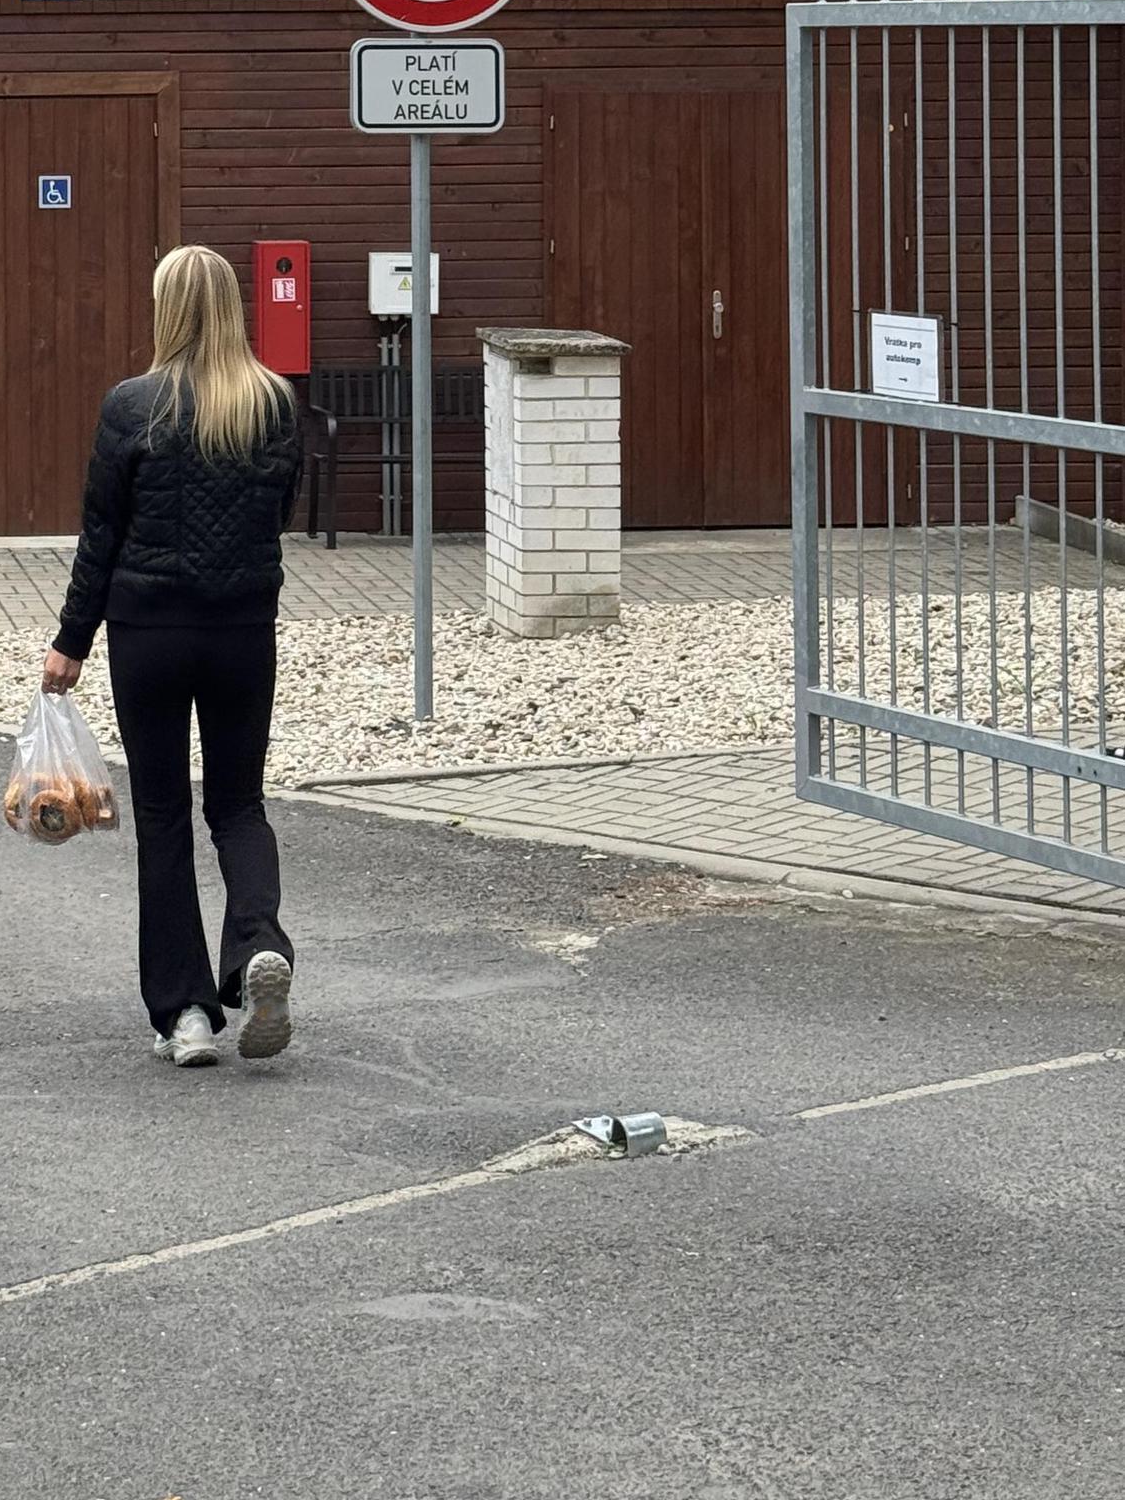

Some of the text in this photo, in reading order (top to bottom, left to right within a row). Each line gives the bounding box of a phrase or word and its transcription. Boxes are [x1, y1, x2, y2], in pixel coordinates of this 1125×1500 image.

[405, 51, 458, 72] PLATÍ
[391, 75, 470, 96] V CELÉM
[393, 100, 468, 120] AREÁLU
[909, 341, 922, 350] pro
